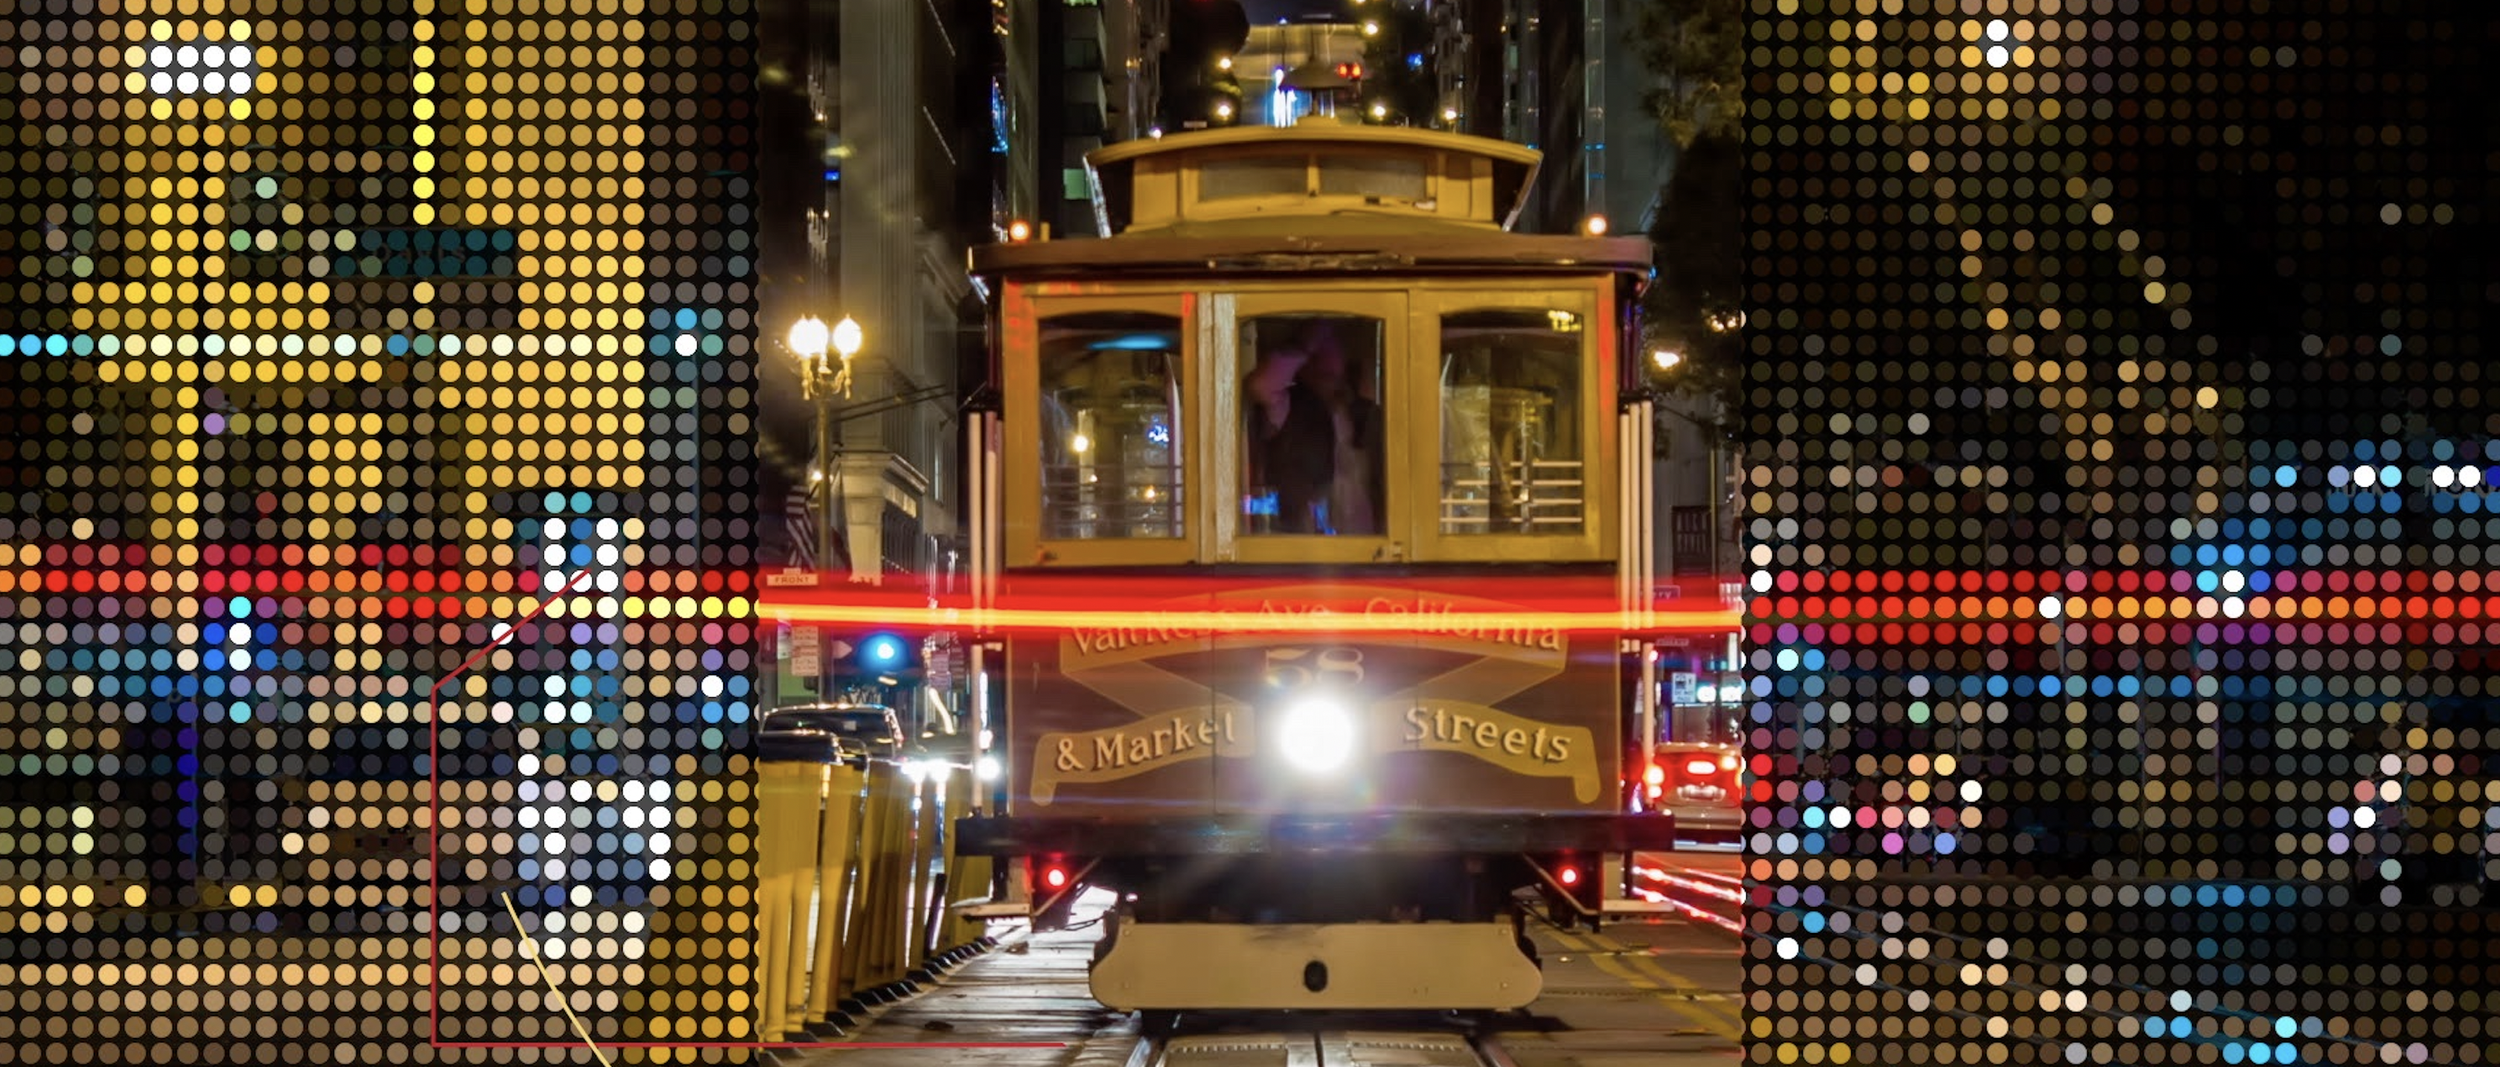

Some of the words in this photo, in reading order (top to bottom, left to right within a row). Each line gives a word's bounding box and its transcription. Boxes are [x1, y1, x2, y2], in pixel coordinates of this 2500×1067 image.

[1071, 617, 1139, 657] Van
[1364, 597, 1560, 650] California
[1265, 648, 1365, 687] 58
[1055, 737, 1085, 771] &
[1093, 712, 1236, 770] Market
[1405, 706, 1572, 762] Streets
